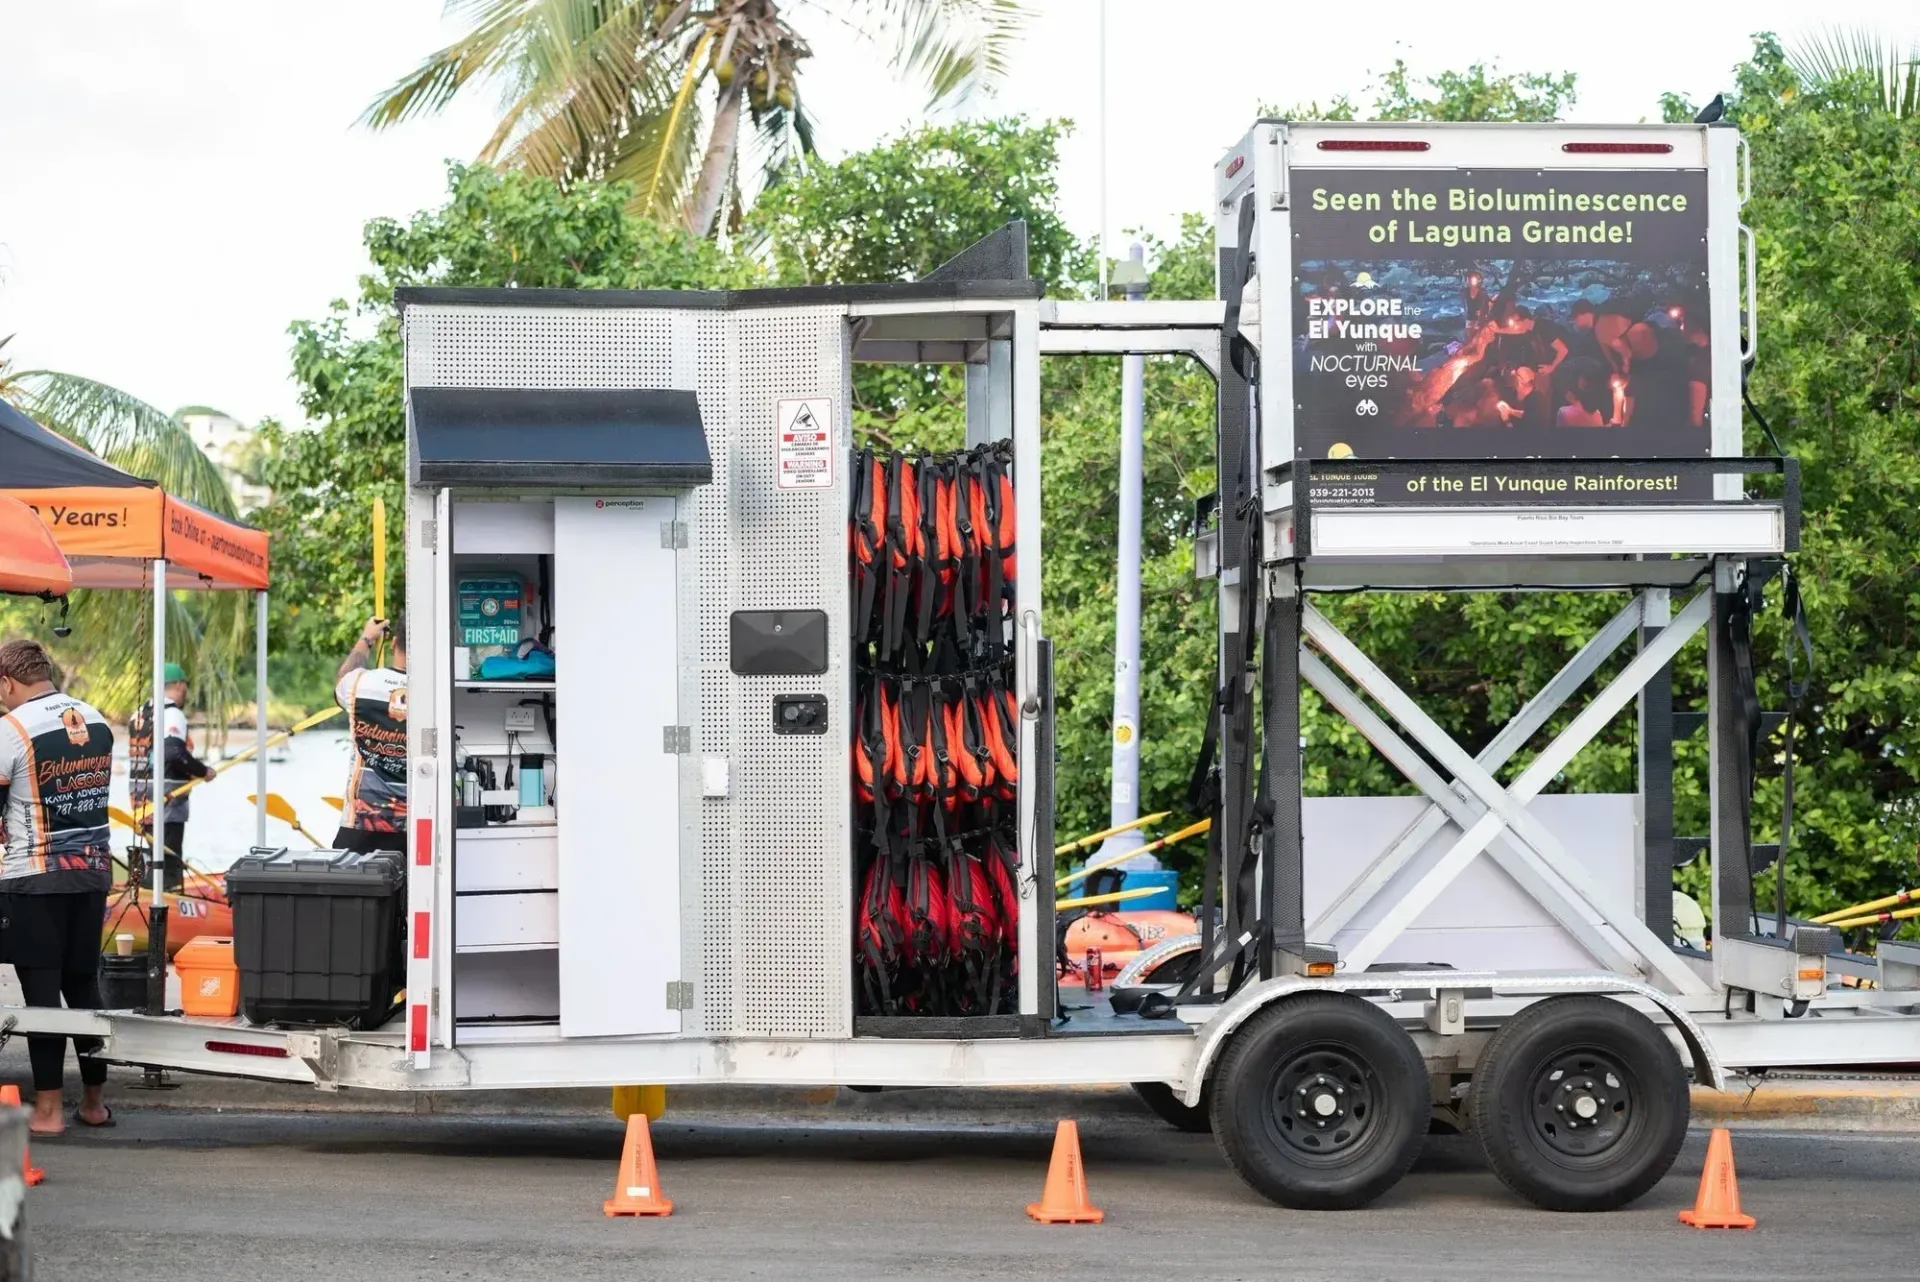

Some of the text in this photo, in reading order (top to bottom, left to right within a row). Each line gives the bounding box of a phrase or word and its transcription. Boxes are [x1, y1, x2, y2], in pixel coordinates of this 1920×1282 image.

[1312, 187, 1688, 212] Seen the Bioluminescence
[1368, 219, 1633, 247] of Laguna Grande!
[1309, 298, 1421, 316] EXPLORE the
[1309, 320, 1423, 342] El Yunque
[1355, 341, 1377, 352] with
[1310, 355, 1423, 372] NOCTURNAL
[1345, 374, 1388, 390] eyes
[1309, 488, 1375, 497] 939-221-2013
[1406, 475, 1678, 495] of the El Yunque Rainforest!
[465, 628, 518, 644] FIRST AID
[56, 770, 109, 793] LAGOON
[45, 792, 73, 805] KAYAK
